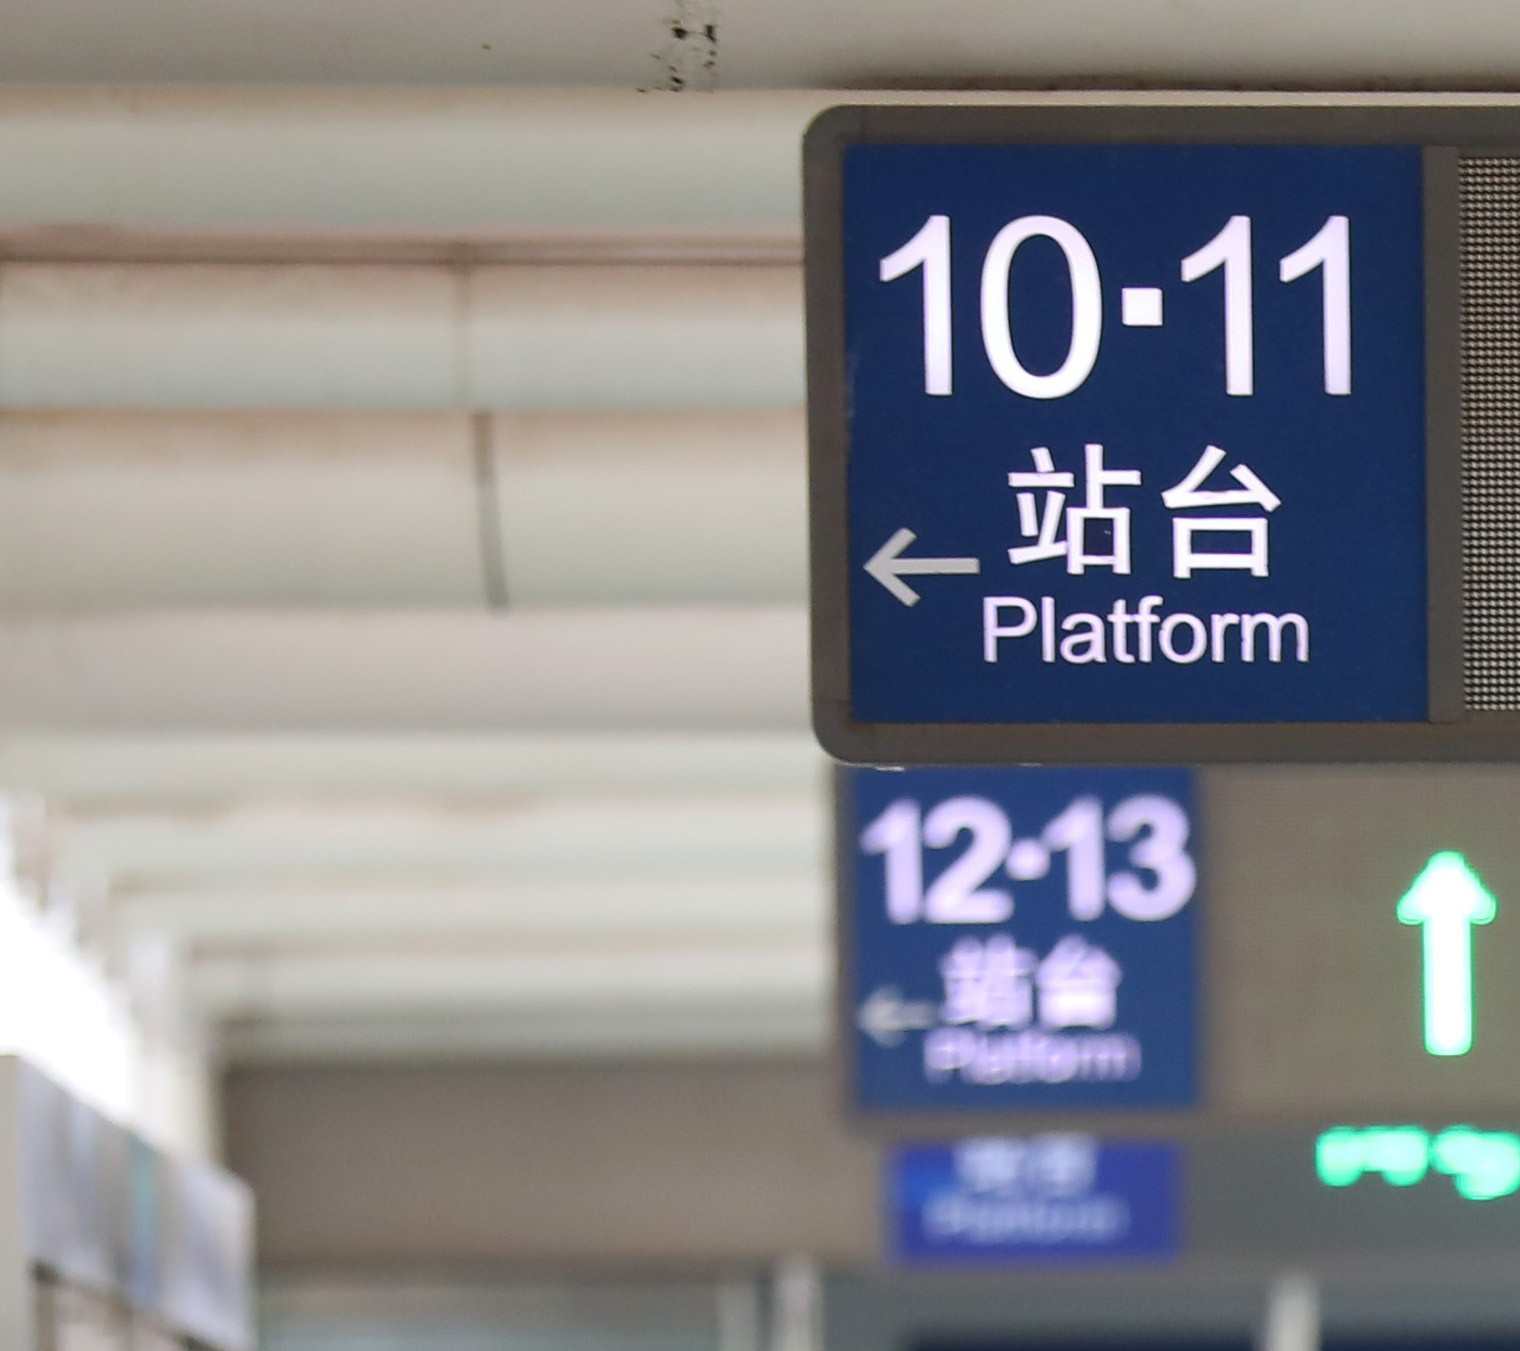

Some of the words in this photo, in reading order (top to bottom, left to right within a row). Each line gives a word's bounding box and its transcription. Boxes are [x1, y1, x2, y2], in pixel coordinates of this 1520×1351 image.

[878, 213, 1353, 398] 10·11
[1006, 444, 1283, 579] 站台
[982, 595, 1309, 664] Platform
